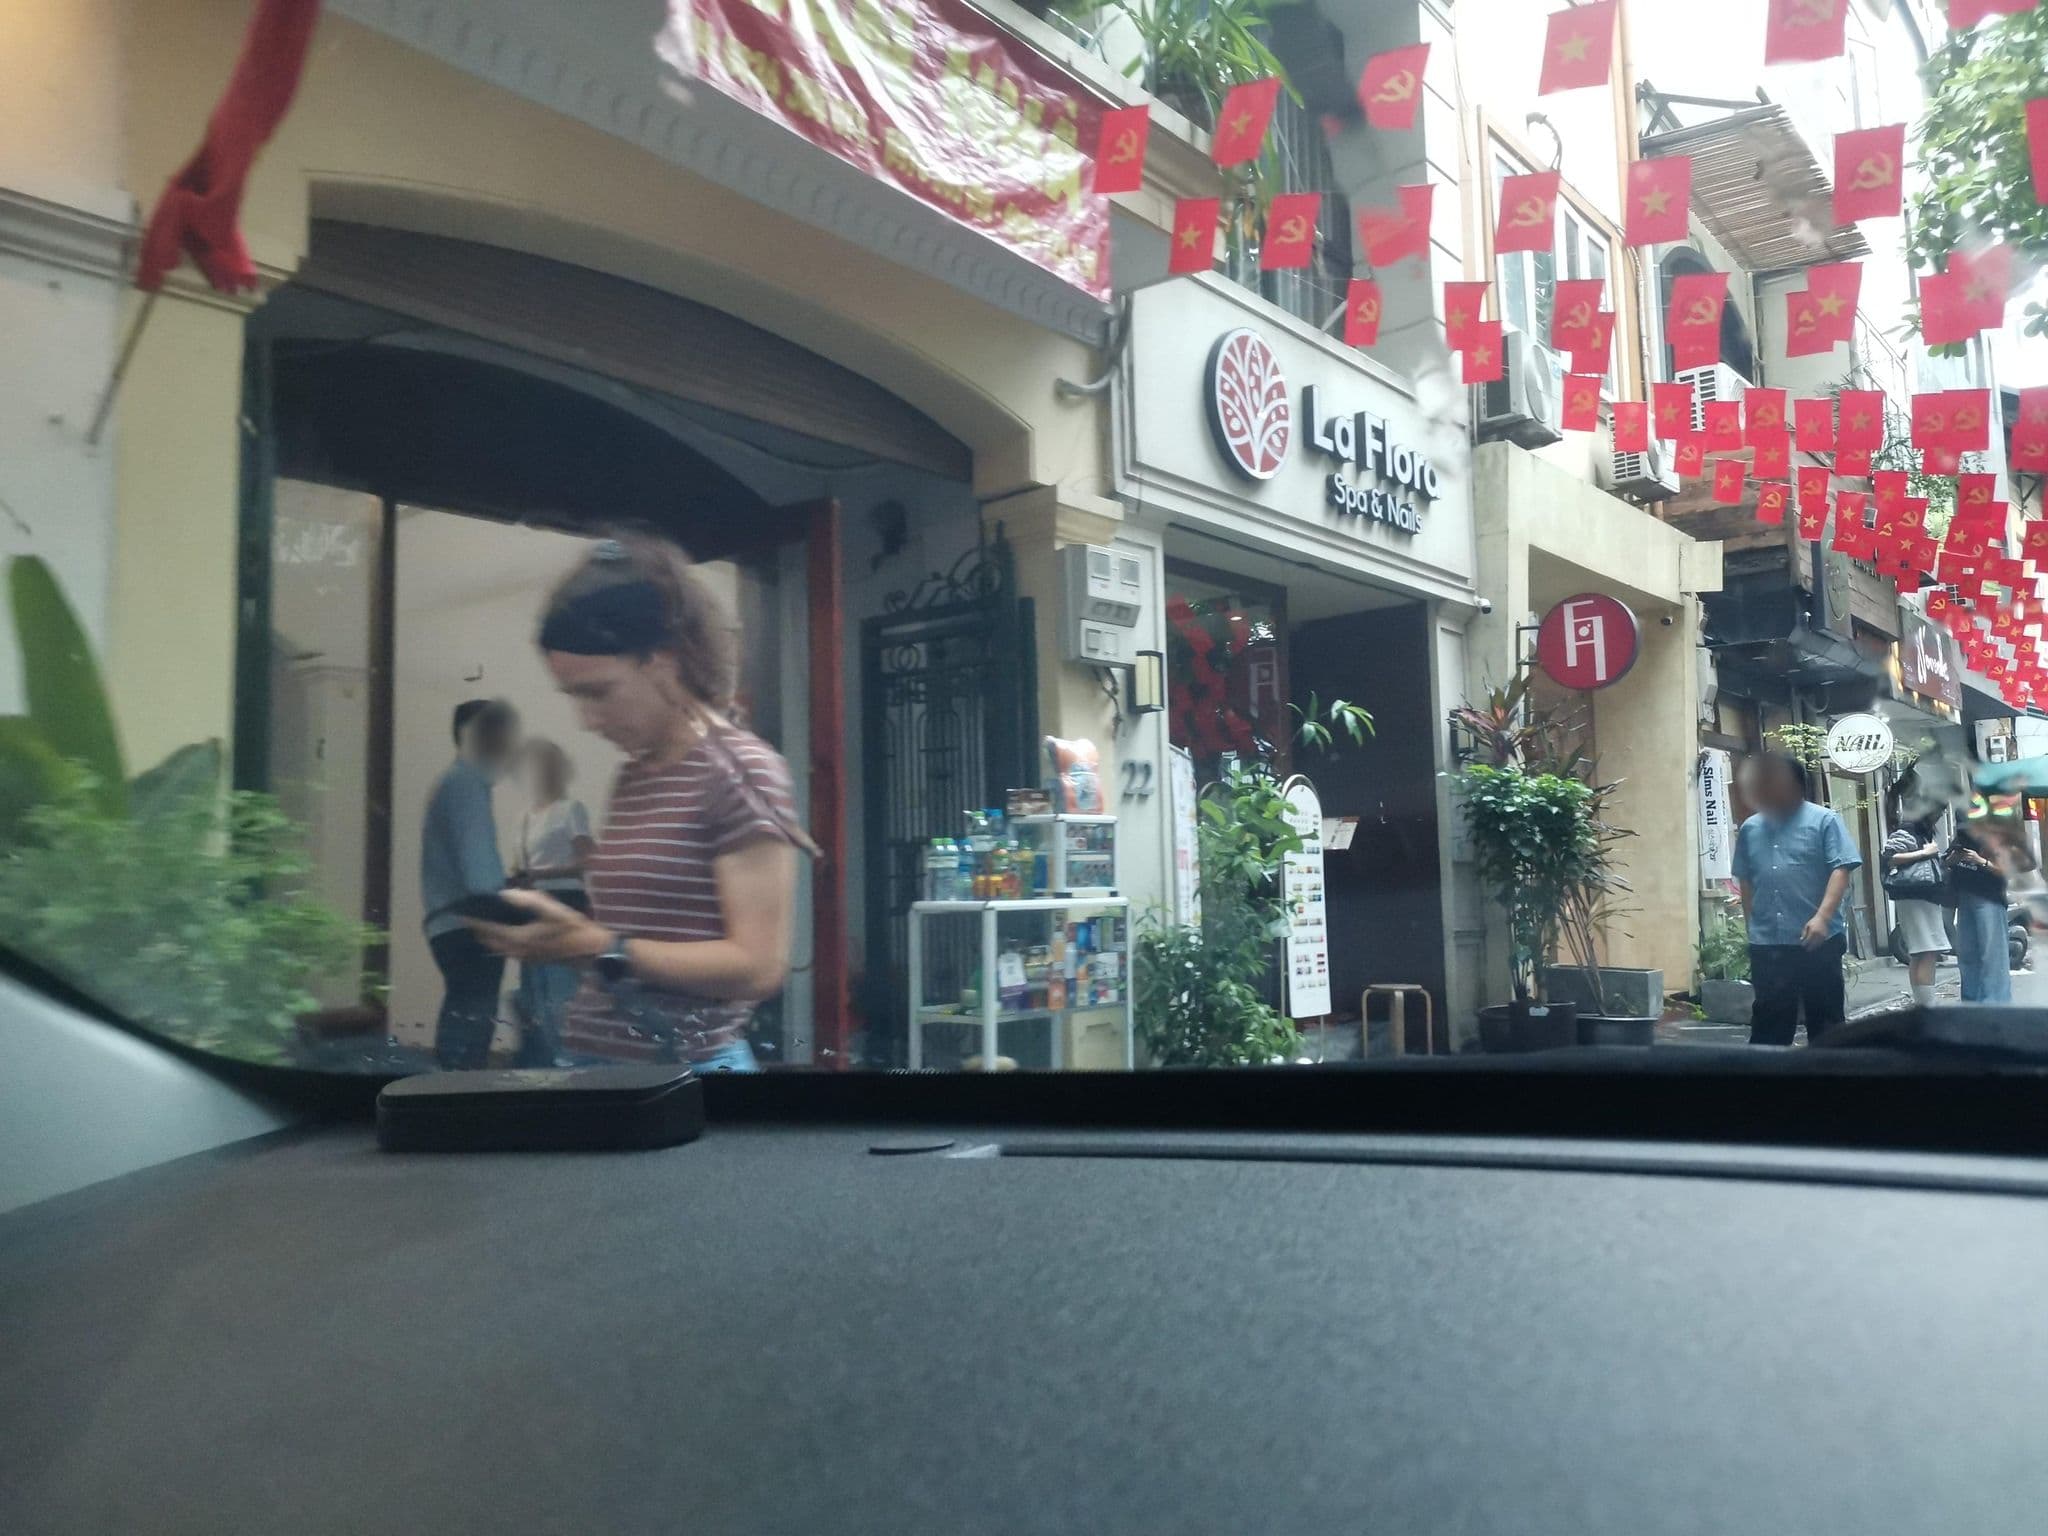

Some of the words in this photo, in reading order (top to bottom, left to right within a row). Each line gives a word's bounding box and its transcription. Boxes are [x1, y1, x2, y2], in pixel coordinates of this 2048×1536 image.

[1303, 385, 1355, 462] La
[1355, 411, 1441, 499] Flora
[1330, 473, 1368, 514] Spa
[1368, 488, 1384, 519] &
[1385, 493, 1424, 533] Nails
[1835, 734, 1885, 752] NAIL
[1121, 760, 1153, 801] 22
[1705, 800, 1718, 825] Nail
